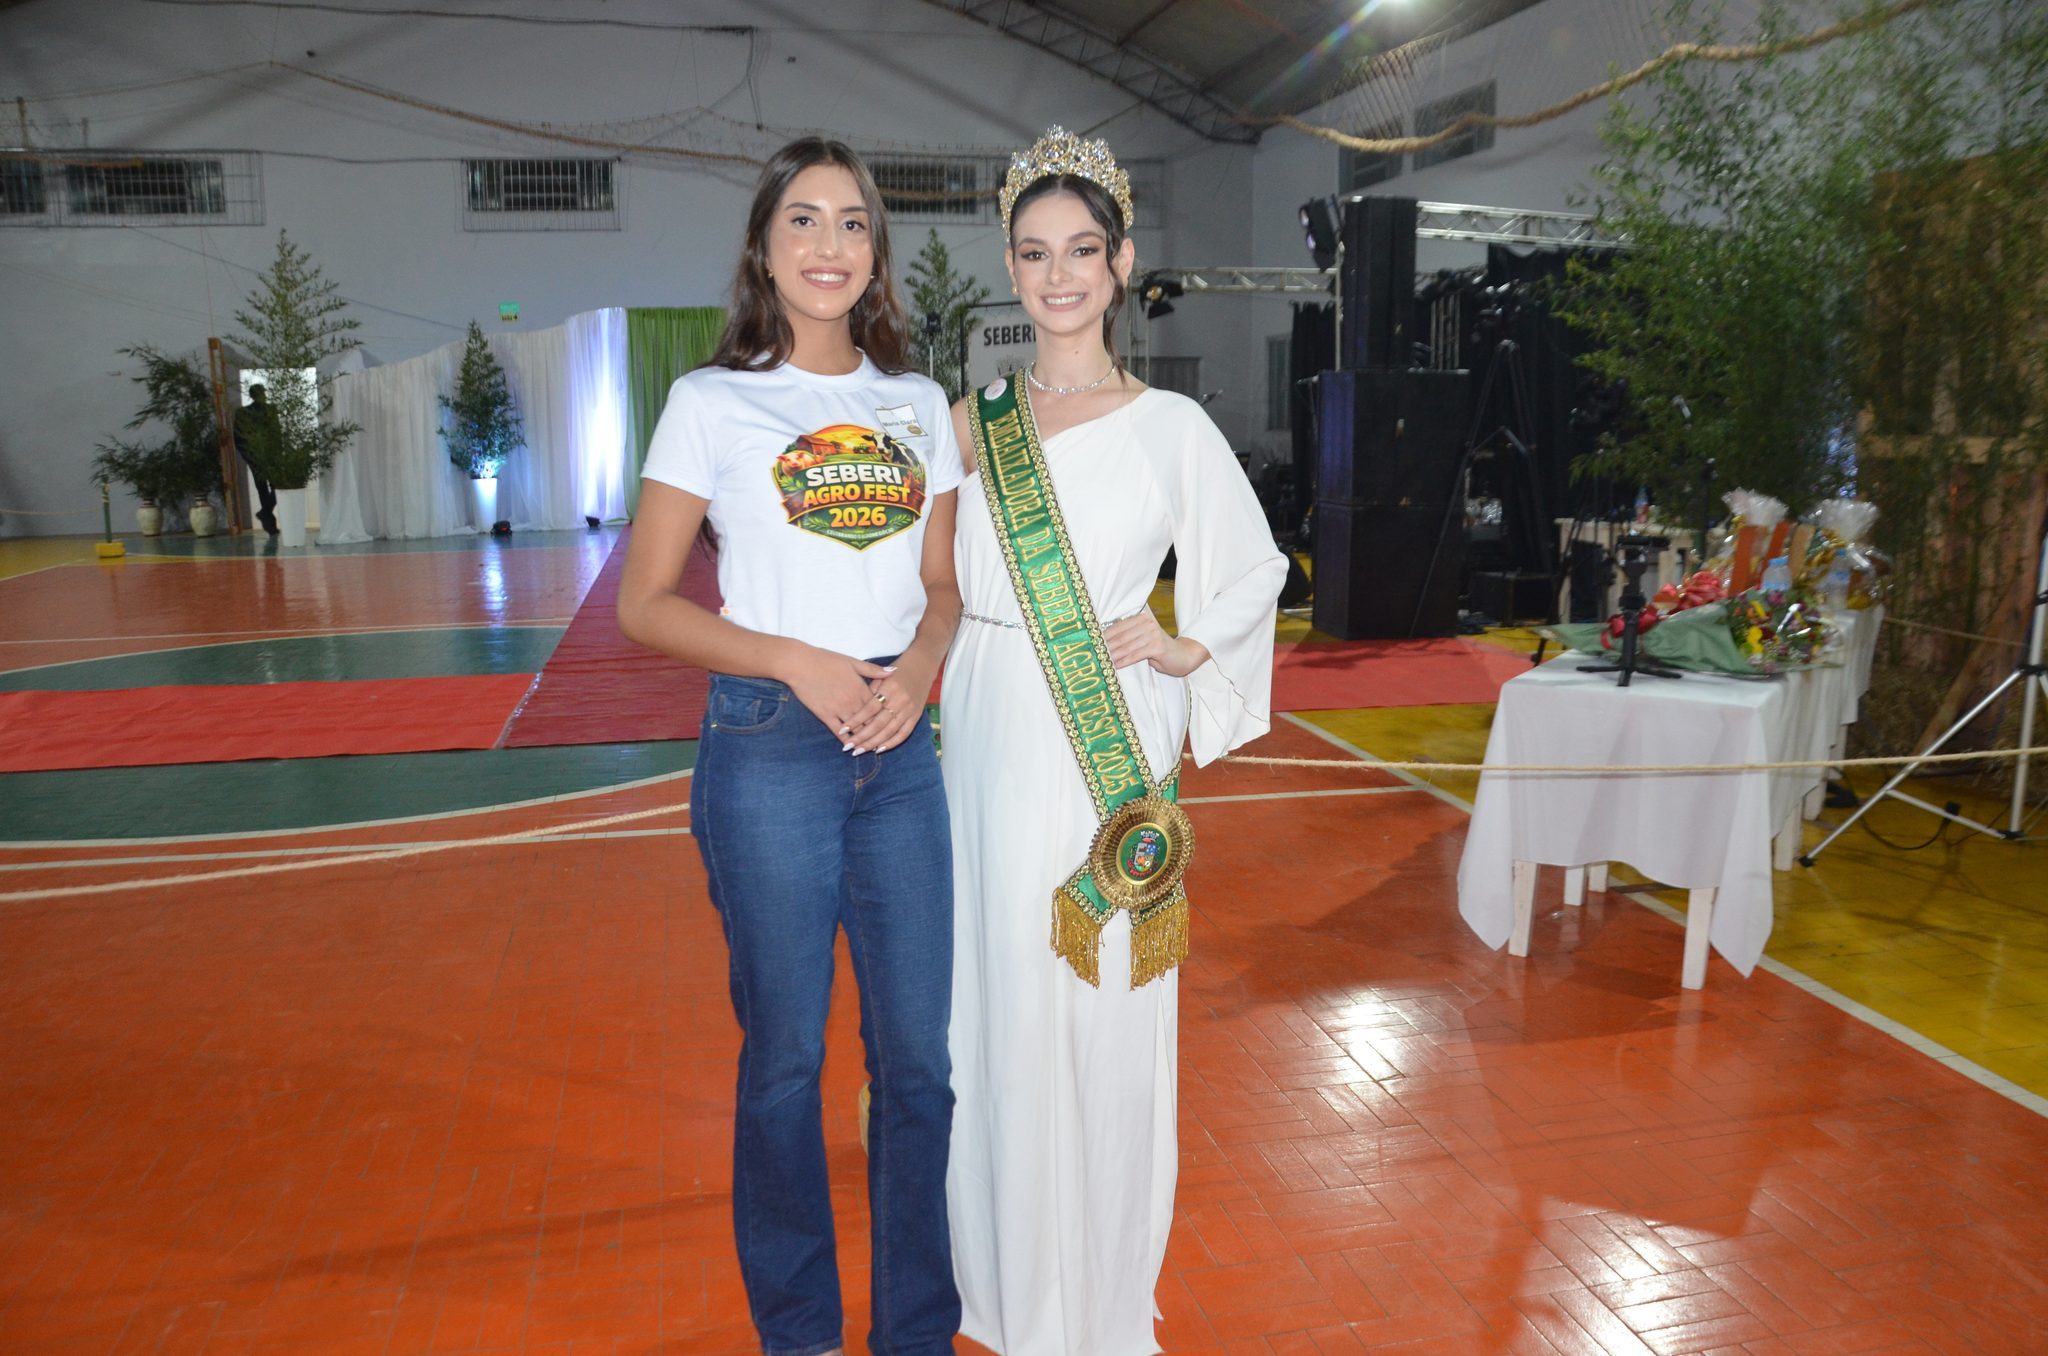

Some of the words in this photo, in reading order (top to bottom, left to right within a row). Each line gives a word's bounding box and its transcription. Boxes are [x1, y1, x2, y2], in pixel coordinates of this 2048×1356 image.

[803, 484, 861, 508] AGRO
[864, 484, 910, 503] FEST
[805, 464, 903, 487] SEBERI
[986, 408, 1045, 532] EMBAIXADORA
[828, 507, 887, 528] 2026
[1016, 527, 1055, 562] DA
[1028, 562, 1082, 640] SEBERI
[1053, 640, 1100, 694] AGRO
[1073, 690, 1118, 744] FEST
[1092, 743, 1139, 795] 2025
